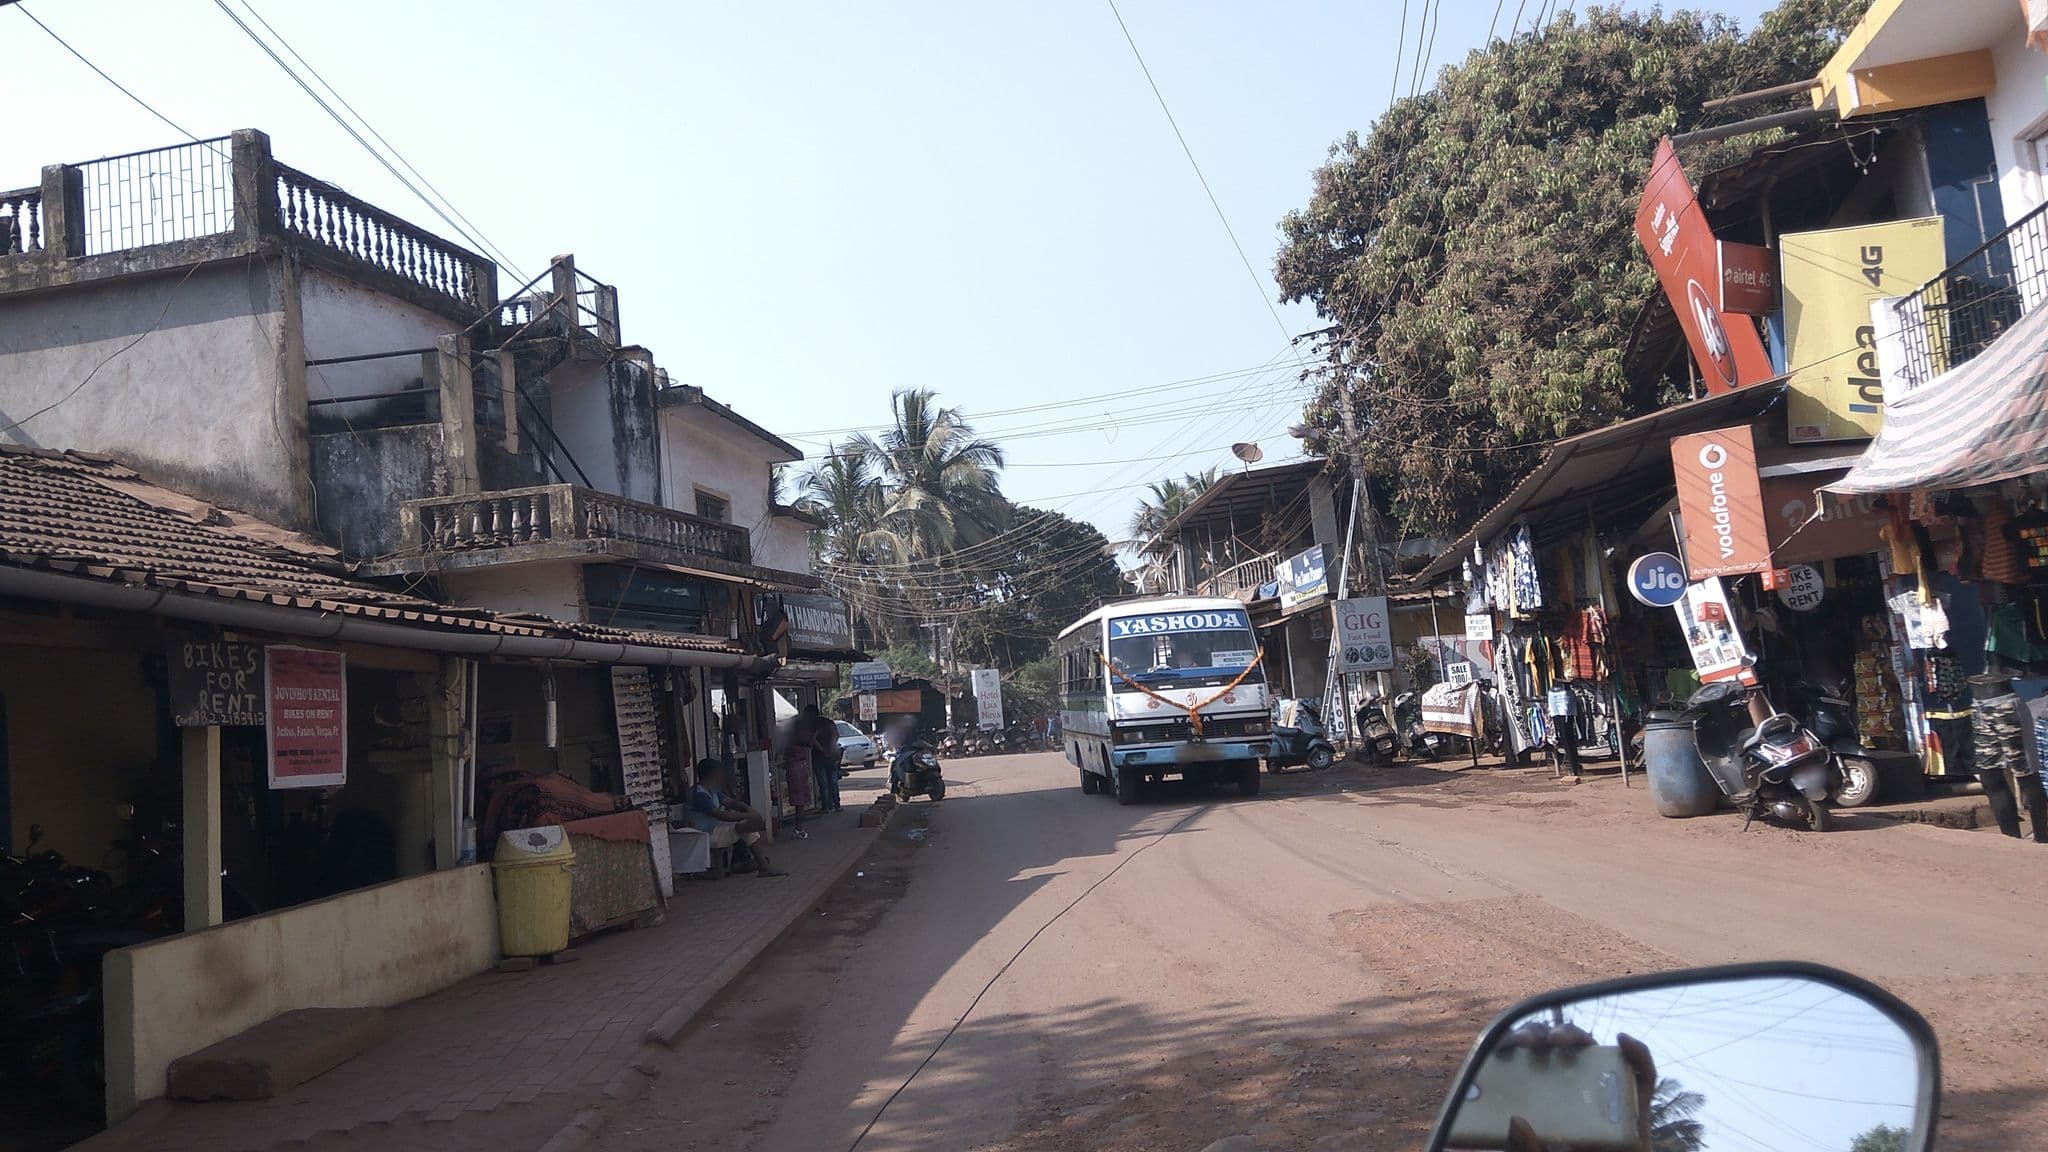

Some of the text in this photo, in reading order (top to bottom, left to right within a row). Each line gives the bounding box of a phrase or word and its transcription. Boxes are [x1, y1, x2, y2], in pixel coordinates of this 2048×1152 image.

[1860, 246, 1883, 287] 4G
[1734, 269, 1772, 287] airtel 4G
[1709, 472, 1735, 560] vodafone
[1642, 566, 1683, 590] Jio
[1693, 567, 1722, 576] Anthony
[1723, 563, 1748, 573] General
[1790, 568, 1813, 583] IKE
[1791, 582, 1812, 593] FOR
[1788, 592, 1821, 608] RENT
[795, 605, 848, 636] HANDICRAFTS
[1115, 613, 1241, 635] YASHODA
[1344, 612, 1381, 631] GIG
[184, 642, 257, 674] BIKE'S
[1451, 665, 1467, 675] SALE
[207, 670, 247, 693] FOR
[200, 690, 256, 715] RENT
[980, 689, 999, 700] Hotel
[284, 709, 334, 719] BIKES ON RENT
[1174, 716, 1210, 724] TAA
